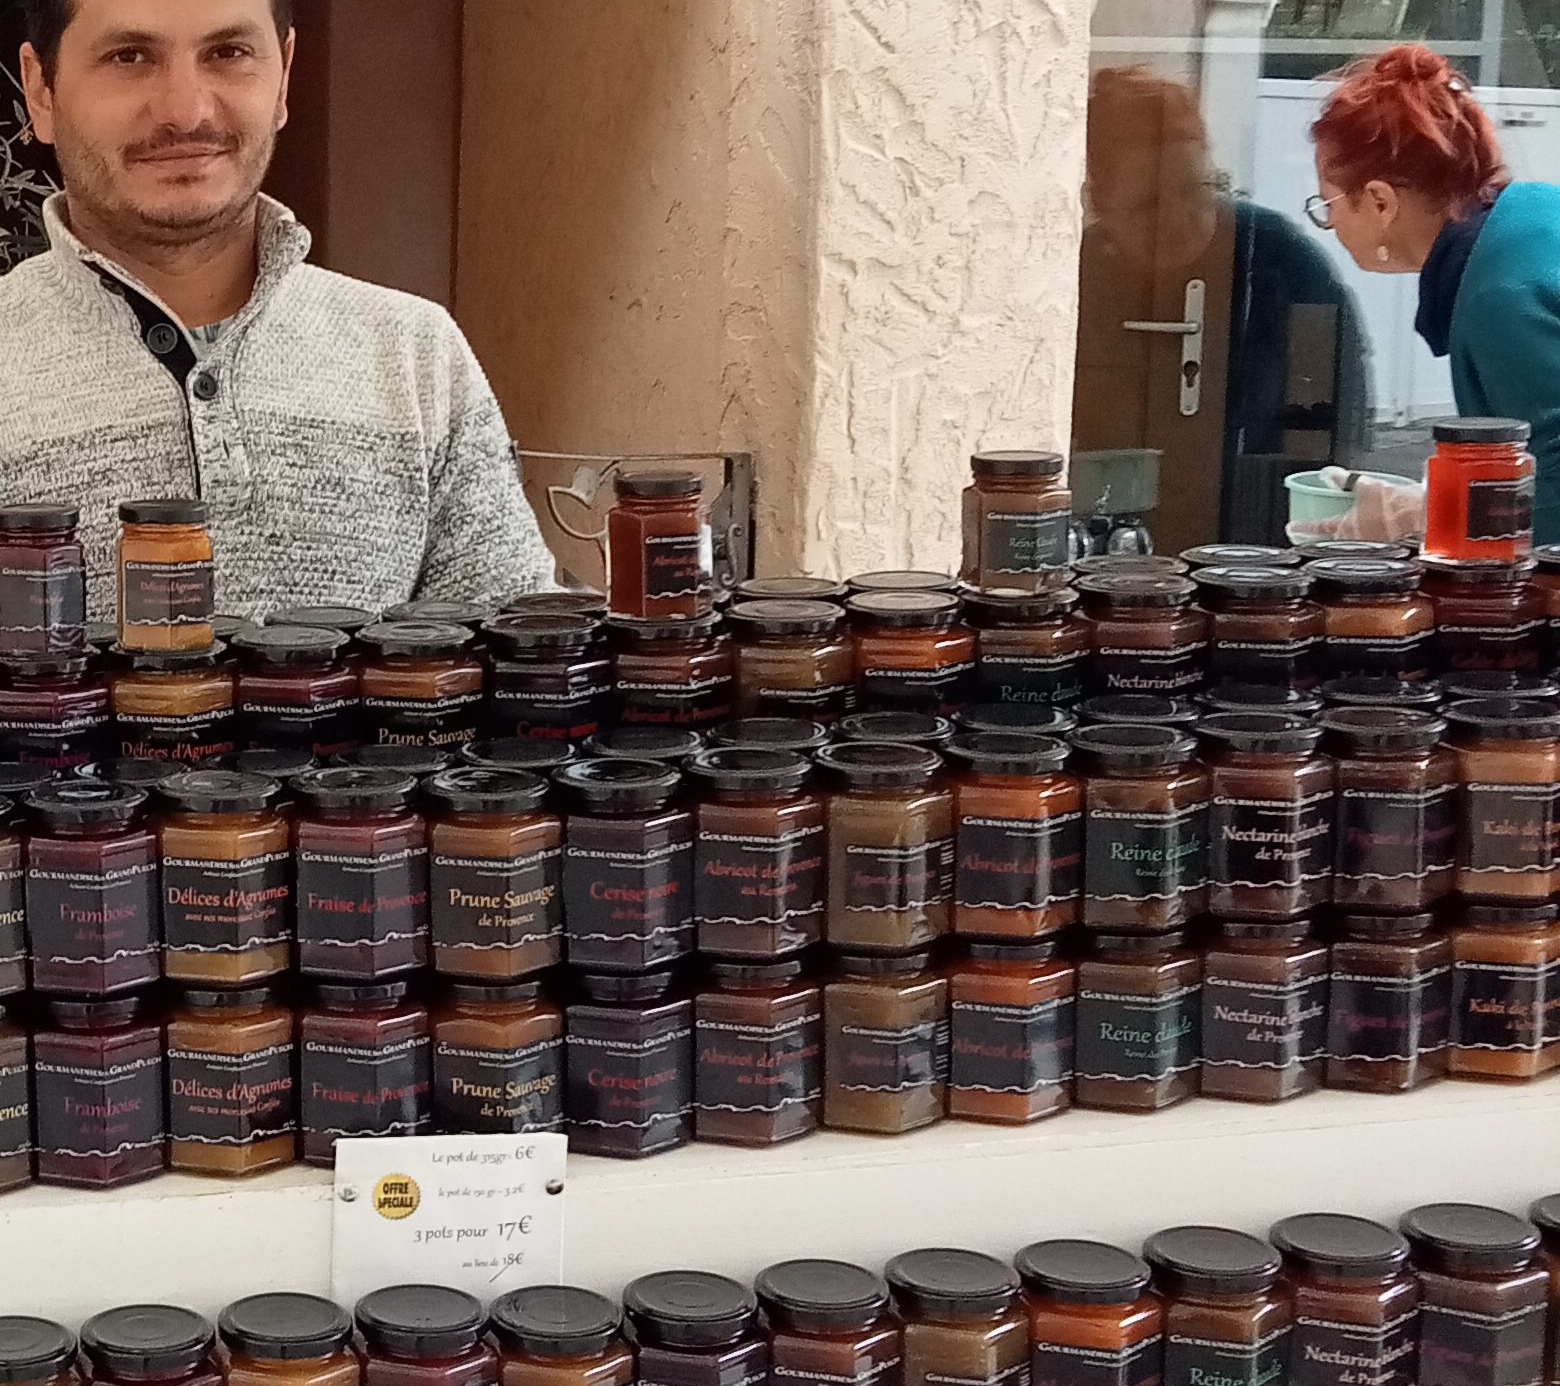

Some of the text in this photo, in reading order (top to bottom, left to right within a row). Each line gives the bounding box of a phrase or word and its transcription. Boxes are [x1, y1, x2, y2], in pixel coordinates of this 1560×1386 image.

[378, 726, 477, 747] Prune Sauvage
[121, 740, 234, 761] Délices d'Agrumes
[1221, 824, 1296, 844] Nectarine
[1110, 842, 1163, 862] Reine
[168, 886, 222, 907] Délices
[223, 885, 290, 911] d'Agrumes
[448, 884, 556, 909] Prune Sauvage
[590, 881, 644, 902] Cerise
[307, 892, 374, 915] Fraise de
[478, 913, 492, 927] de
[1213, 1004, 1287, 1027] Nectarine
[1100, 1021, 1152, 1044] Reine
[172, 1076, 293, 1103] Délices d'Agrumes
[450, 1073, 557, 1100] Prune Sauvage
[589, 1068, 644, 1090] Cerise
[312, 1082, 359, 1103] Fraise
[480, 1103, 494, 1117] de
[447, 1151, 463, 1165] pot
[466, 1150, 479, 1162] de
[515, 1145, 536, 1161] 6€
[383, 1182, 409, 1195] OFFRE
[413, 1215, 532, 1243] 3 pots pour 17€
[1304, 1344, 1381, 1369] Nectarine
